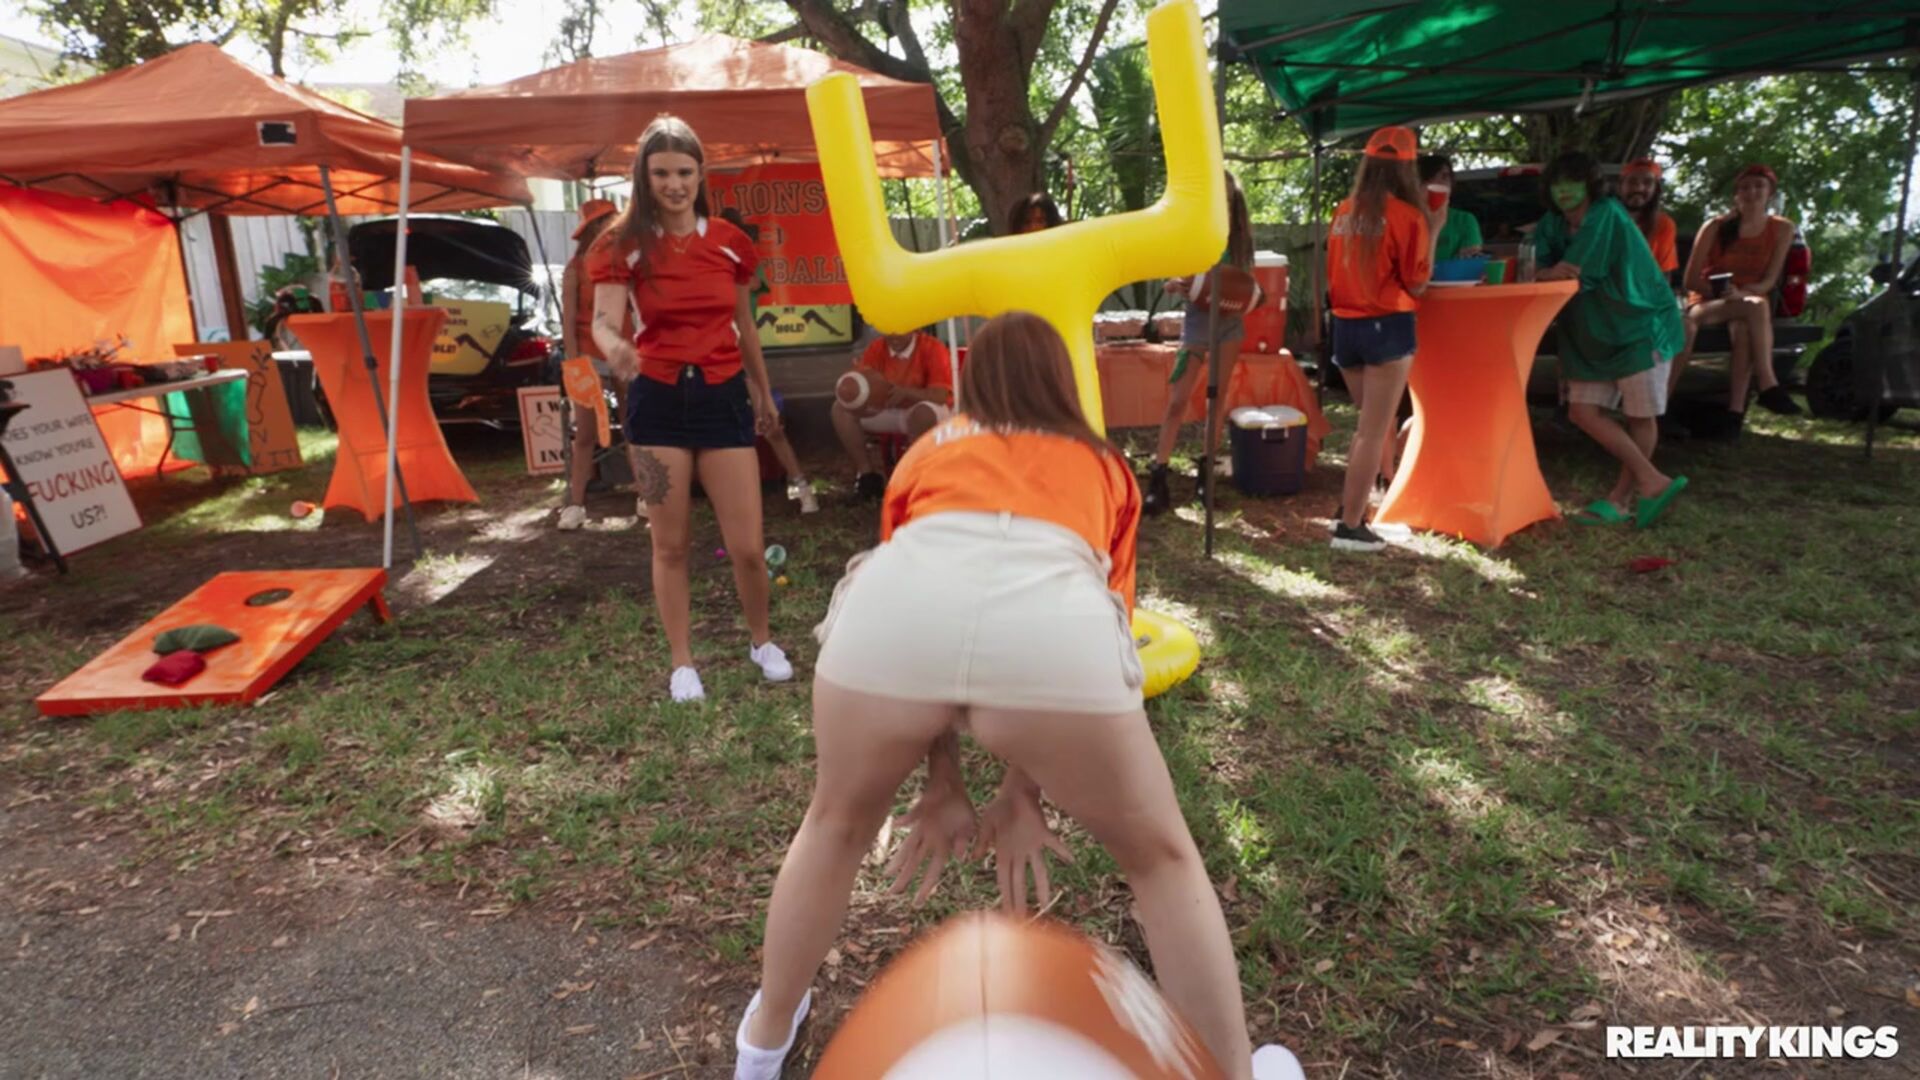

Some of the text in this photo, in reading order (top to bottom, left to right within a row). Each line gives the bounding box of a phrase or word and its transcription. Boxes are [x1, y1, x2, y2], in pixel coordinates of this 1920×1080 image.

[712, 181, 826, 216] LIONS
[548, 401, 560, 412] W
[31, 420, 63, 435] YOUR
[66, 414, 91, 428] WIFE
[16, 448, 53, 465] KNOW
[26, 460, 117, 503] FUCKING
[70, 504, 108, 529] US?!
